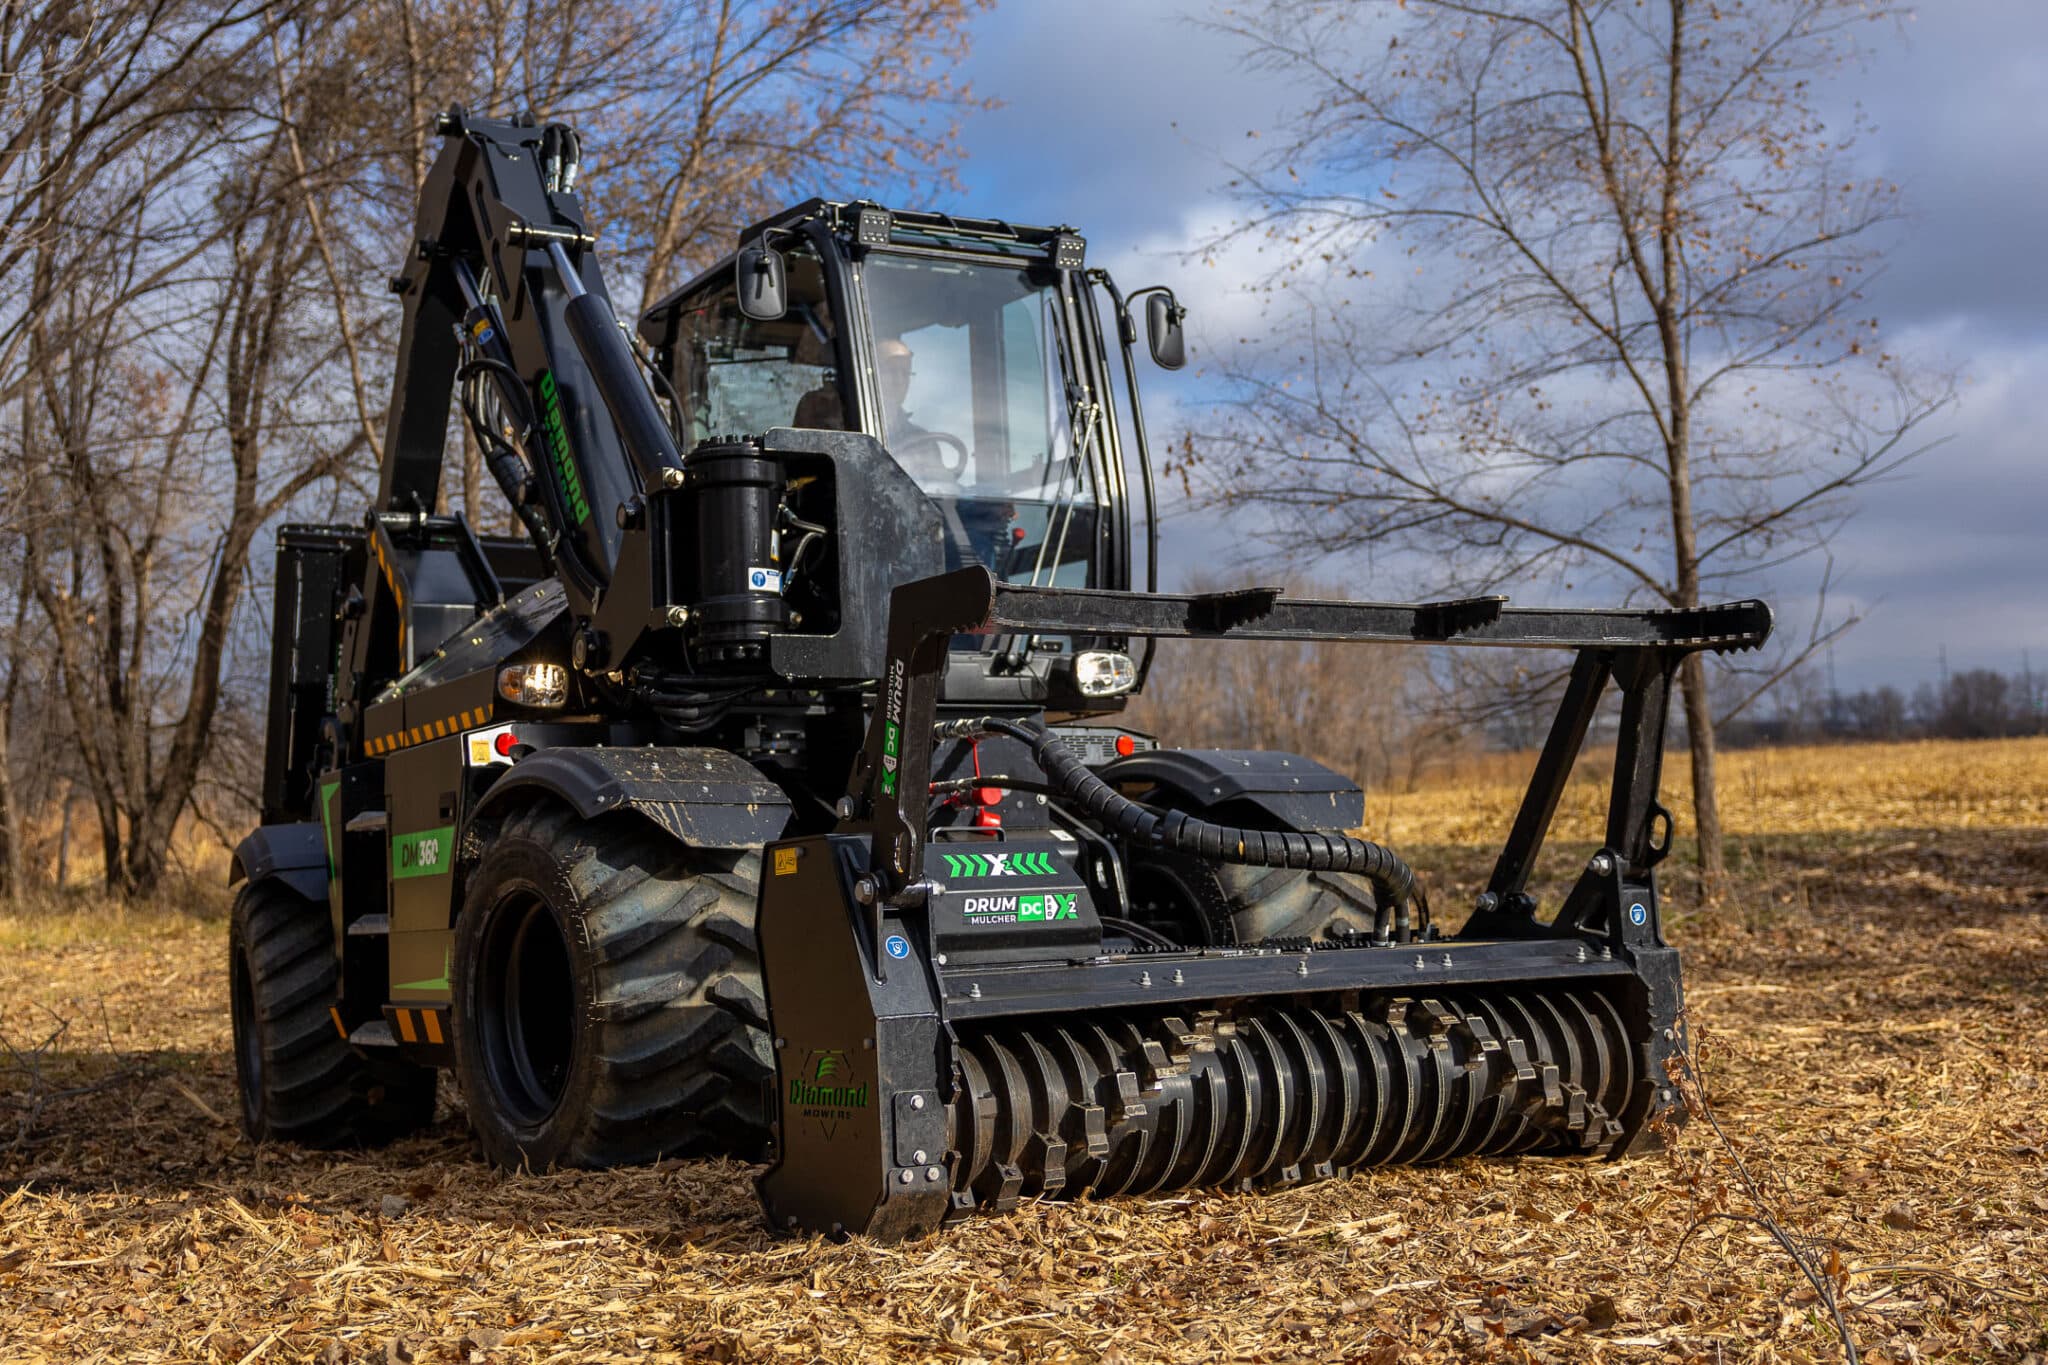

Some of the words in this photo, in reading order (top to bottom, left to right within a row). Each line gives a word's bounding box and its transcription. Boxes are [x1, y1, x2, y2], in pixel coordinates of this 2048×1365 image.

[540, 368, 590, 526] Diamond
[886, 664, 895, 719] MULCHER
[892, 658, 904, 724] DRUM
[887, 727, 897, 753] DC
[402, 838, 439, 869] DM360
[964, 896, 1017, 914] DRUM
[1021, 902, 1042, 916] DC
[971, 914, 1017, 925] MULCHER
[790, 1080, 868, 1108] Diamond
